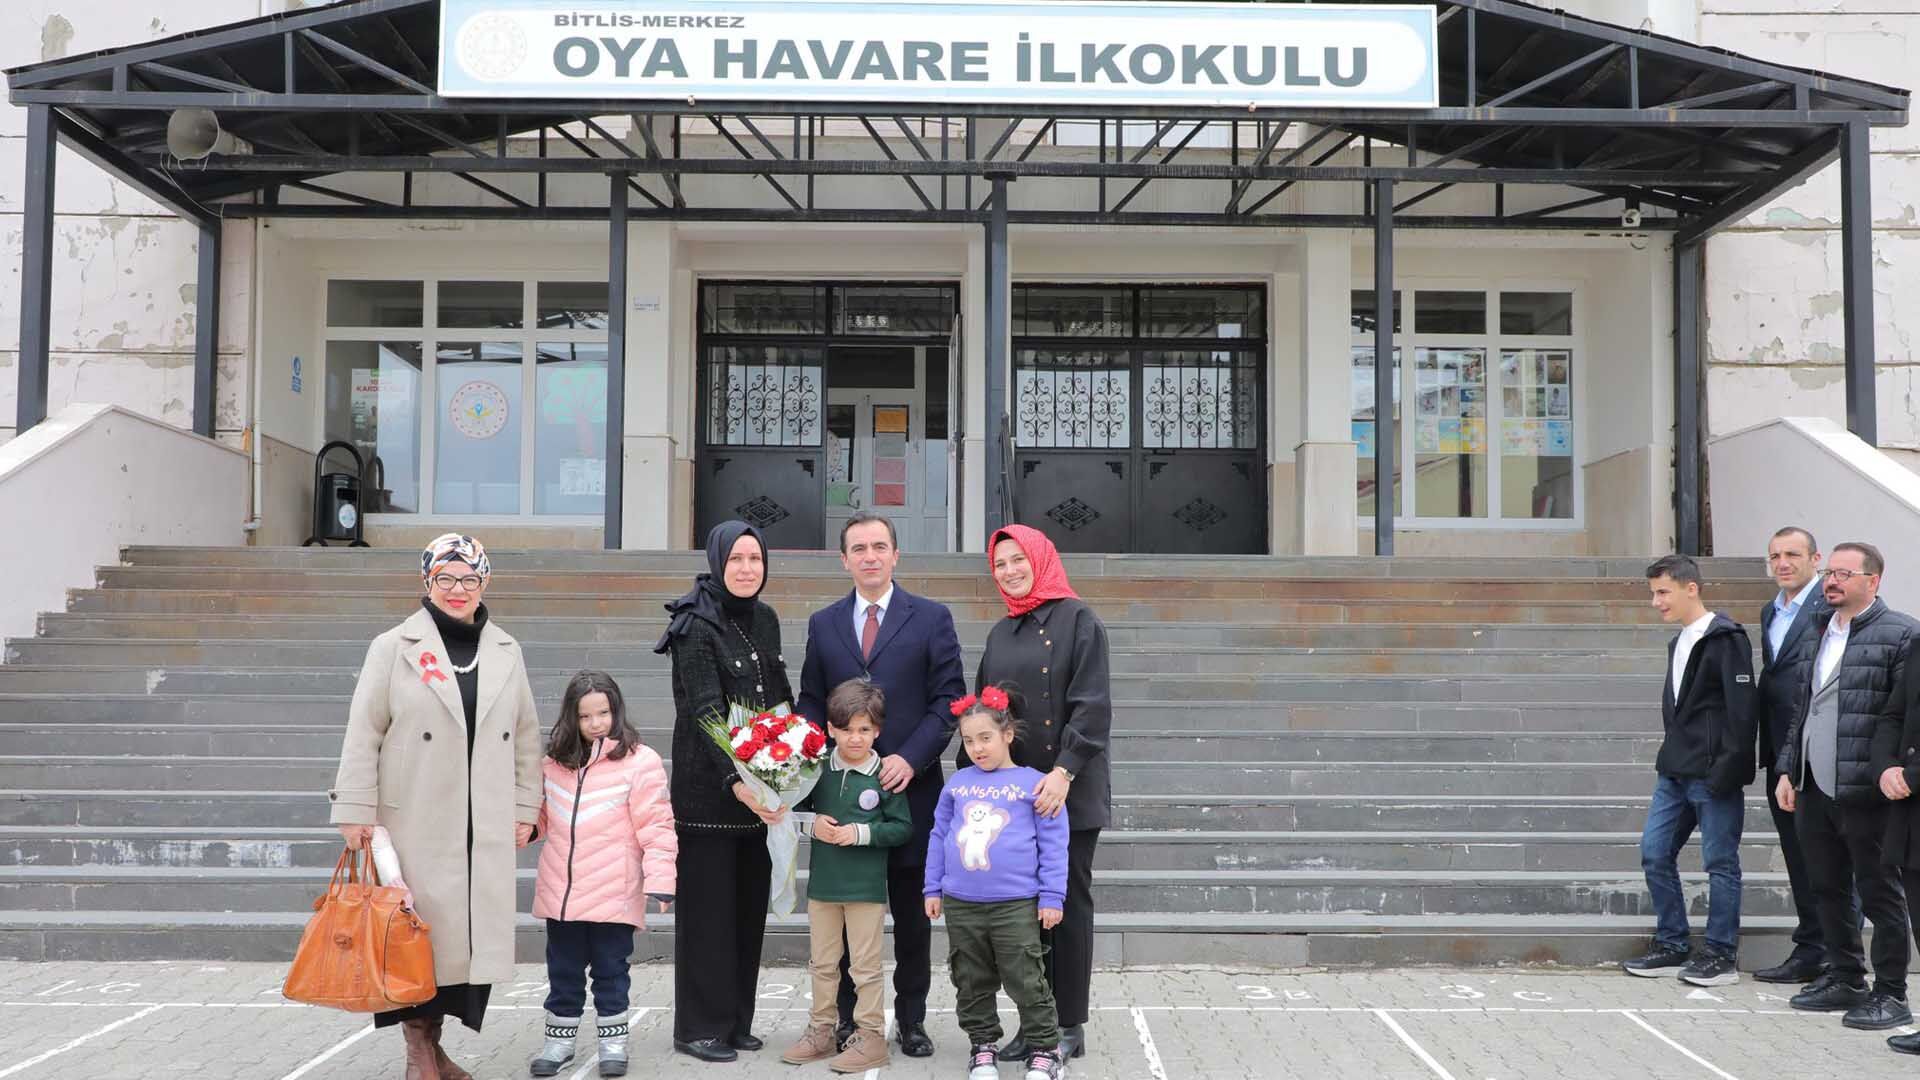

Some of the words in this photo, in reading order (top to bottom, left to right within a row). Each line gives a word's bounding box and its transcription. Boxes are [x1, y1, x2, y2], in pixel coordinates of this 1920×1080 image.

[553, 12, 745, 29] BİTLİS-MERKEZ
[553, 36, 688, 79] OYA
[713, 38, 989, 82] HAVARE
[1016, 32, 1368, 87] İLKOKULU
